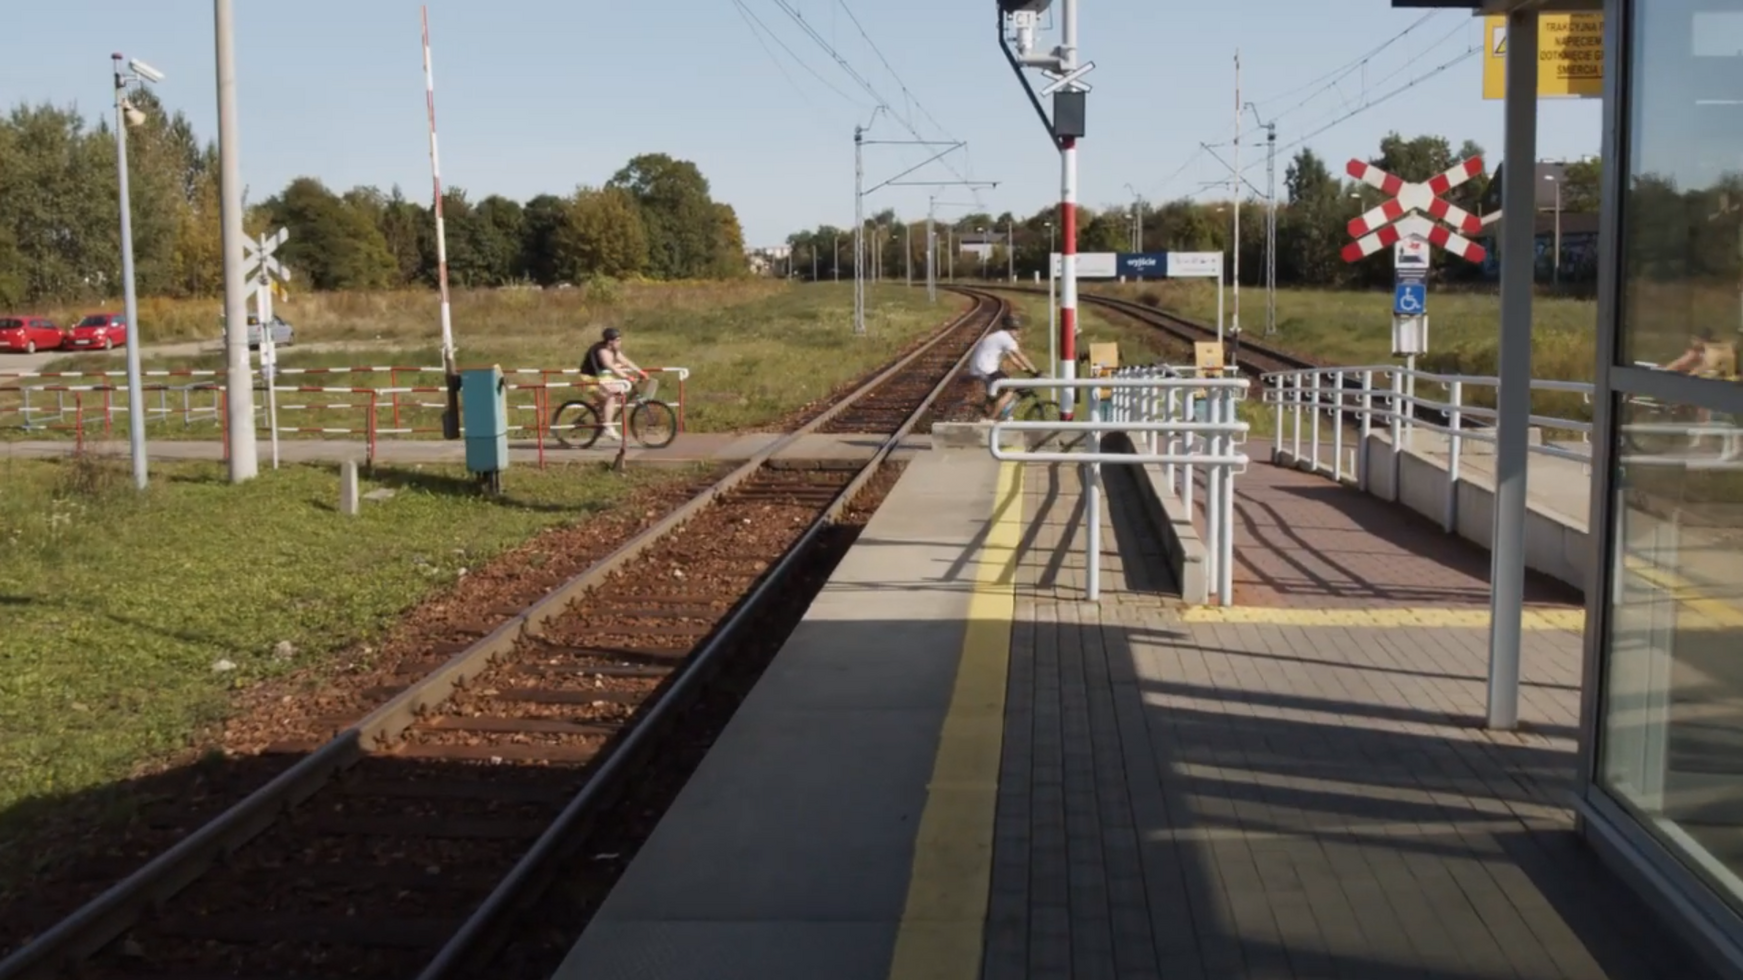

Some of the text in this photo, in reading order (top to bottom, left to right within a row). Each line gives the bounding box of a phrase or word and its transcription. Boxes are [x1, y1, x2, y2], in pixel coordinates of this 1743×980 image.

[1015, 13, 1031, 25] C1
[1546, 22, 1598, 32] TRAKCYJNA
[1127, 257, 1156, 268] wyjście
